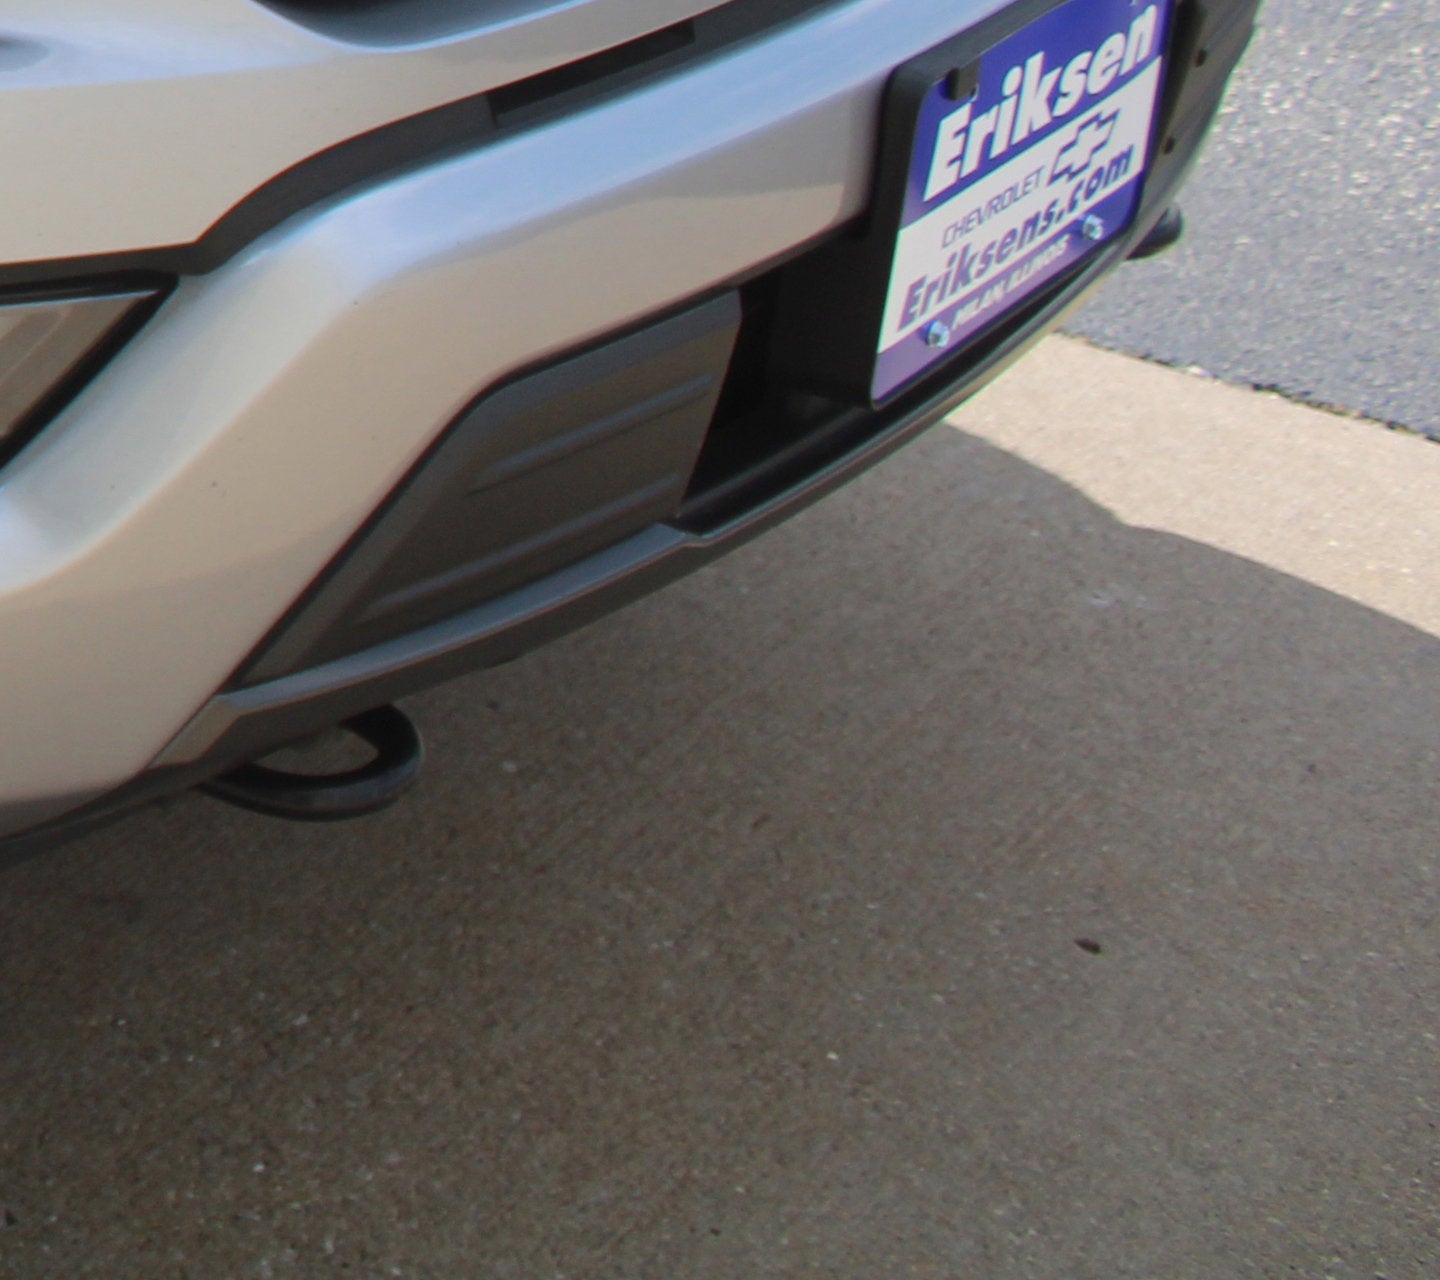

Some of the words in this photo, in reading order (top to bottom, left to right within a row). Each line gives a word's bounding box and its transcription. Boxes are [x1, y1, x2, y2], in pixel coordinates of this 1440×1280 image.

[923, 5, 1157, 202] Eriksen
[897, 144, 1135, 333] Eriksens.com
[941, 164, 1047, 249] CHEVROLET
